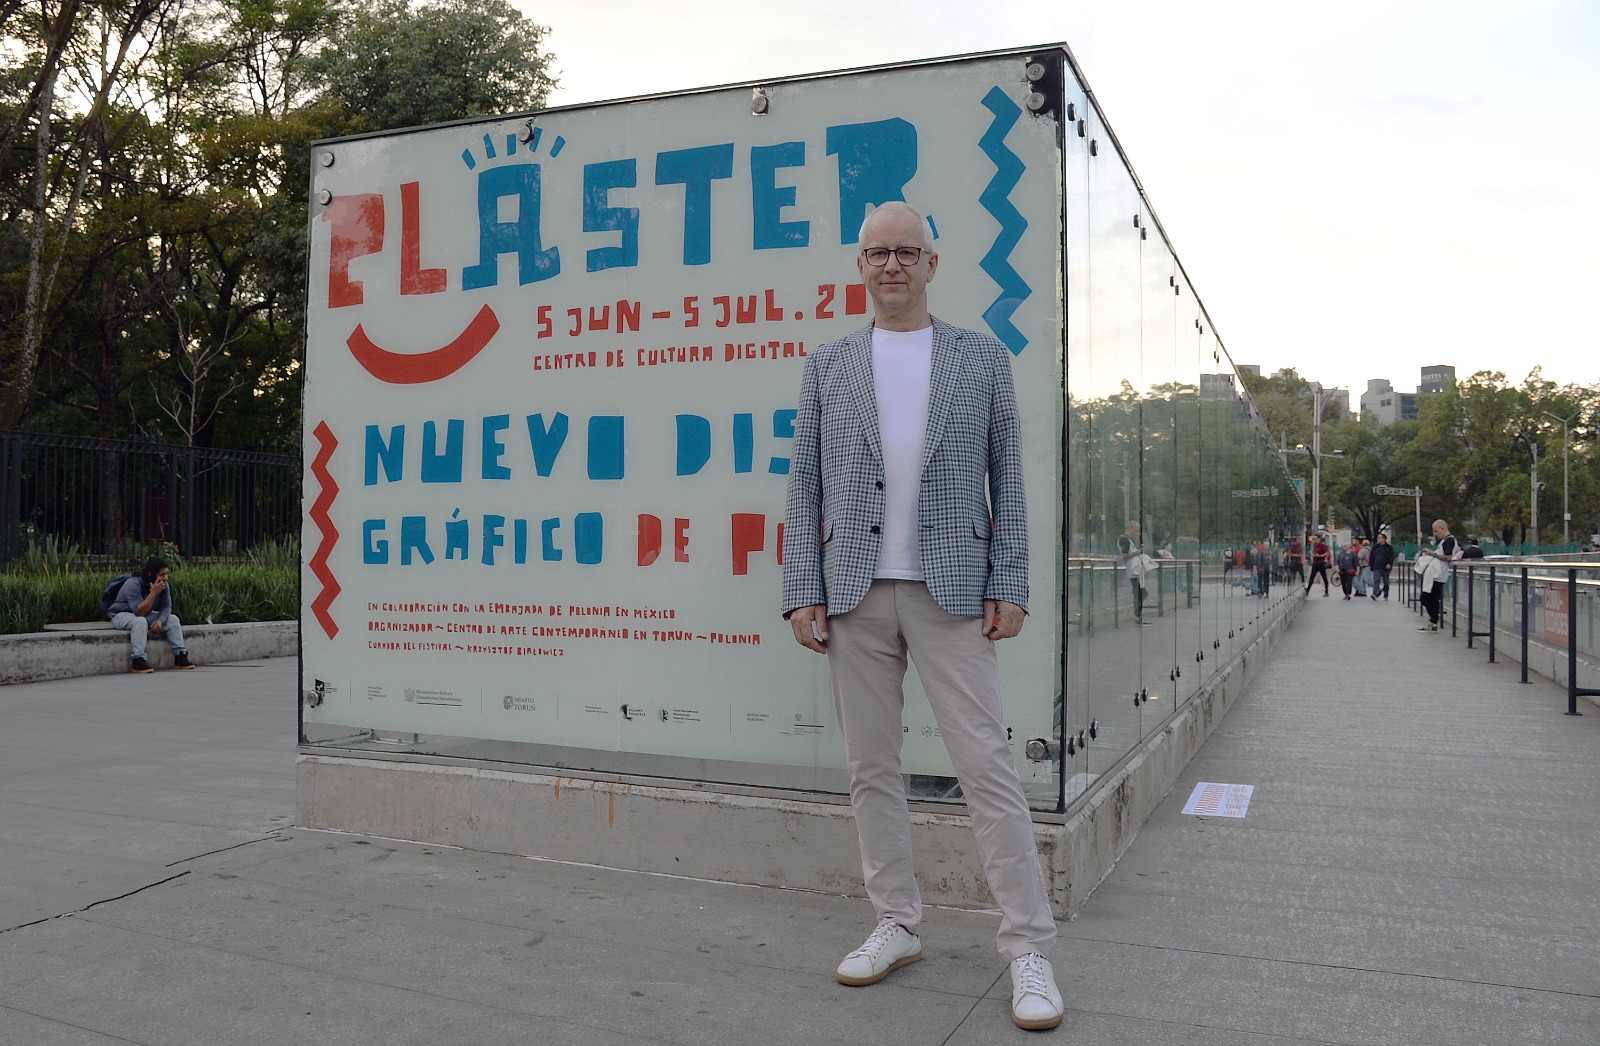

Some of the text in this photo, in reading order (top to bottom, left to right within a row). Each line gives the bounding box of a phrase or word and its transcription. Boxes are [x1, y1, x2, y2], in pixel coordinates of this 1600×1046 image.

[322, 117, 940, 309] PLASTER
[537, 305, 553, 339] 5
[567, 299, 641, 336] JUN
[684, 296, 700, 328] 5
[534, 341, 808, 371] CENTRO DE CULTURA DIGITAL
[363, 411, 625, 488] NUEVO
[362, 507, 604, 567] GRÁFICO
[637, 513, 690, 567] DE
[367, 602, 676, 619] EN COLABORACIÓN CON LA EMBAJADA DE POLONIA EN MÉXICO
[368, 621, 432, 632] ORGANIZADOR
[447, 623, 484, 634] CENTRO
[486, 625, 497, 634] DE
[500, 626, 526, 635] ARTE
[532, 626, 629, 639] CONTEMPORÁNEO
[633, 630, 647, 640] EN
[652, 630, 692, 642] TORUN
[710, 632, 760, 645] POLONIA
[368, 640, 401, 651] CURADOR
[403, 642, 416, 651] DEL
[418, 642, 453, 651] FESTIVAL
[468, 645, 512, 654] KRZYSZTOF
